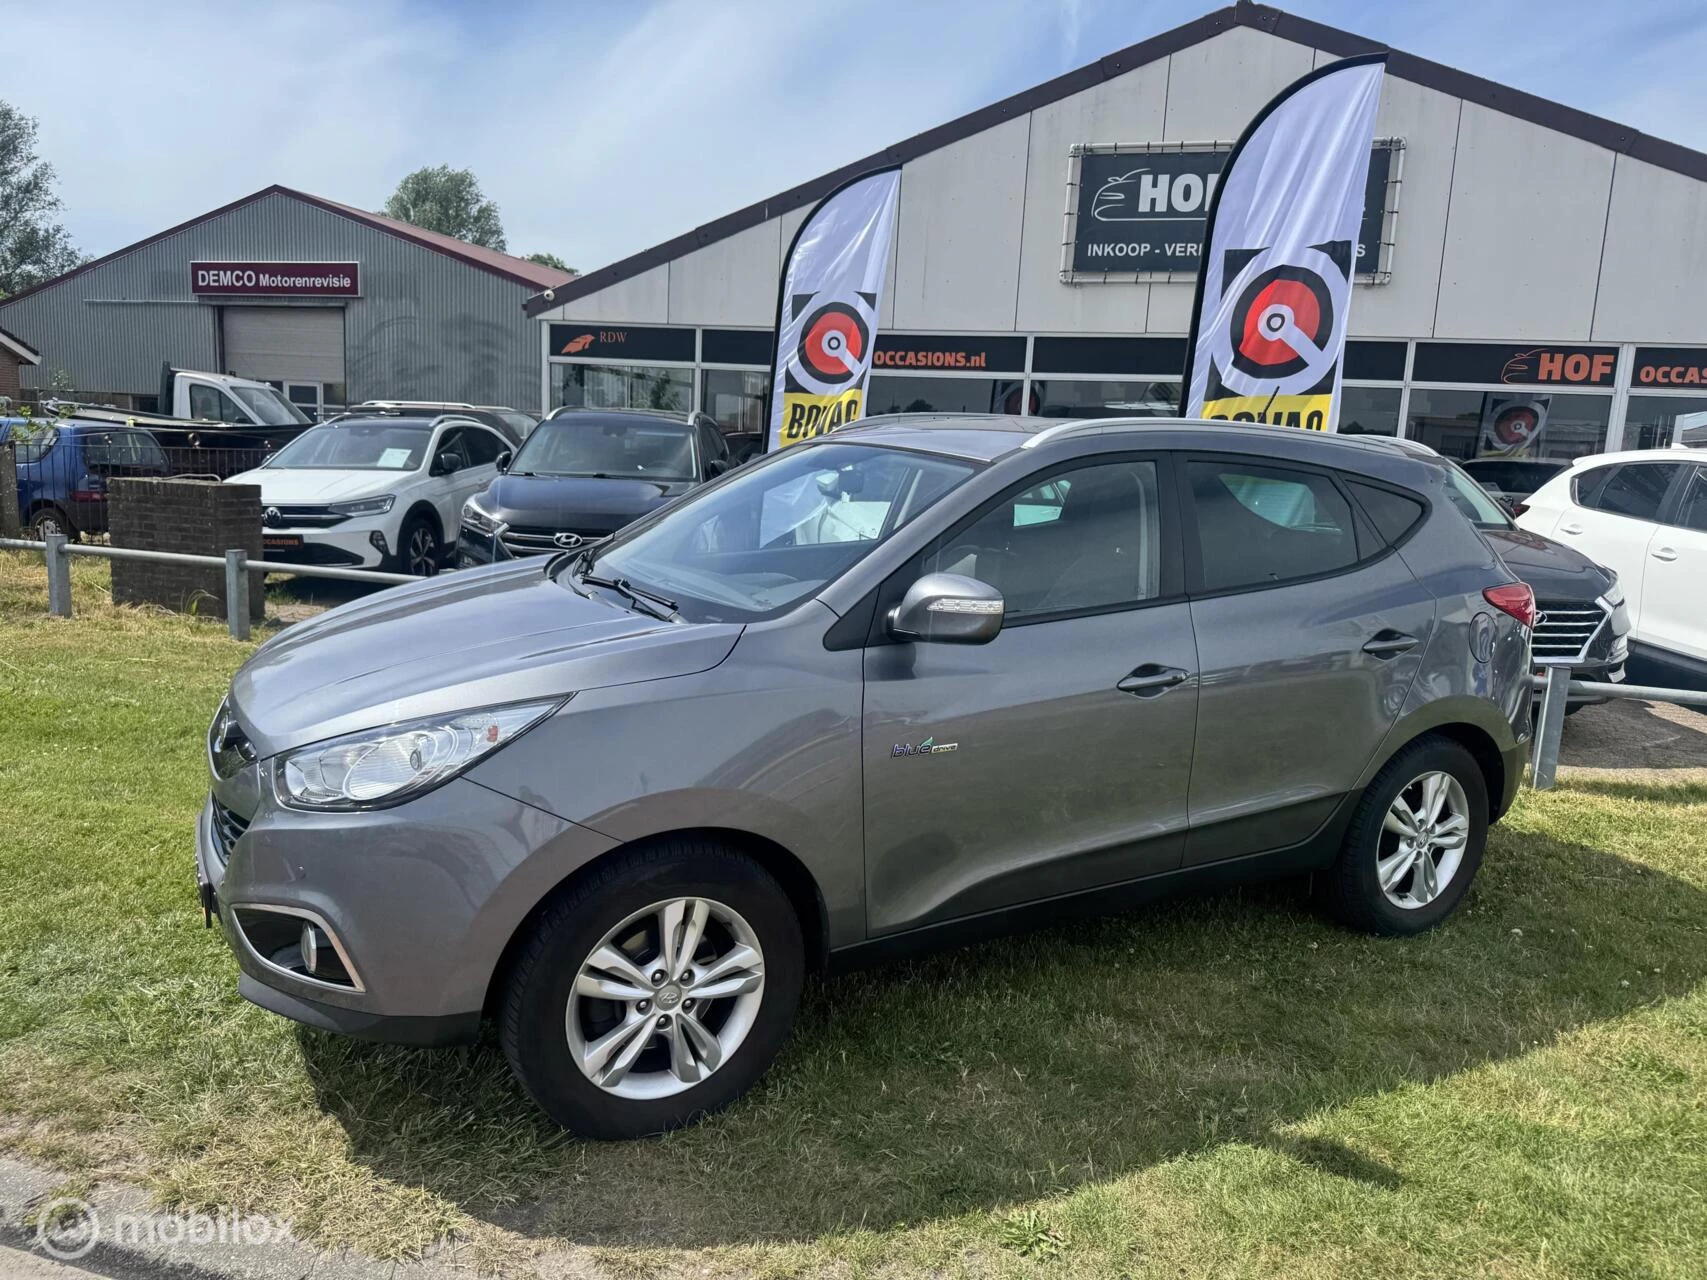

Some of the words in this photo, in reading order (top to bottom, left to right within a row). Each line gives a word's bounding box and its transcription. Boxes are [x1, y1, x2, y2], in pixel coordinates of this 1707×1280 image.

[1087, 243, 1150, 257] INKOOP
[198, 270, 256, 286] DEMCO
[259, 273, 351, 288] Motorenrevisie
[600, 331, 628, 343] RDW
[873, 351, 986, 367] OCCASIONS.nl
[1537, 353, 1615, 382] HOF
[892, 744, 931, 758] blue
